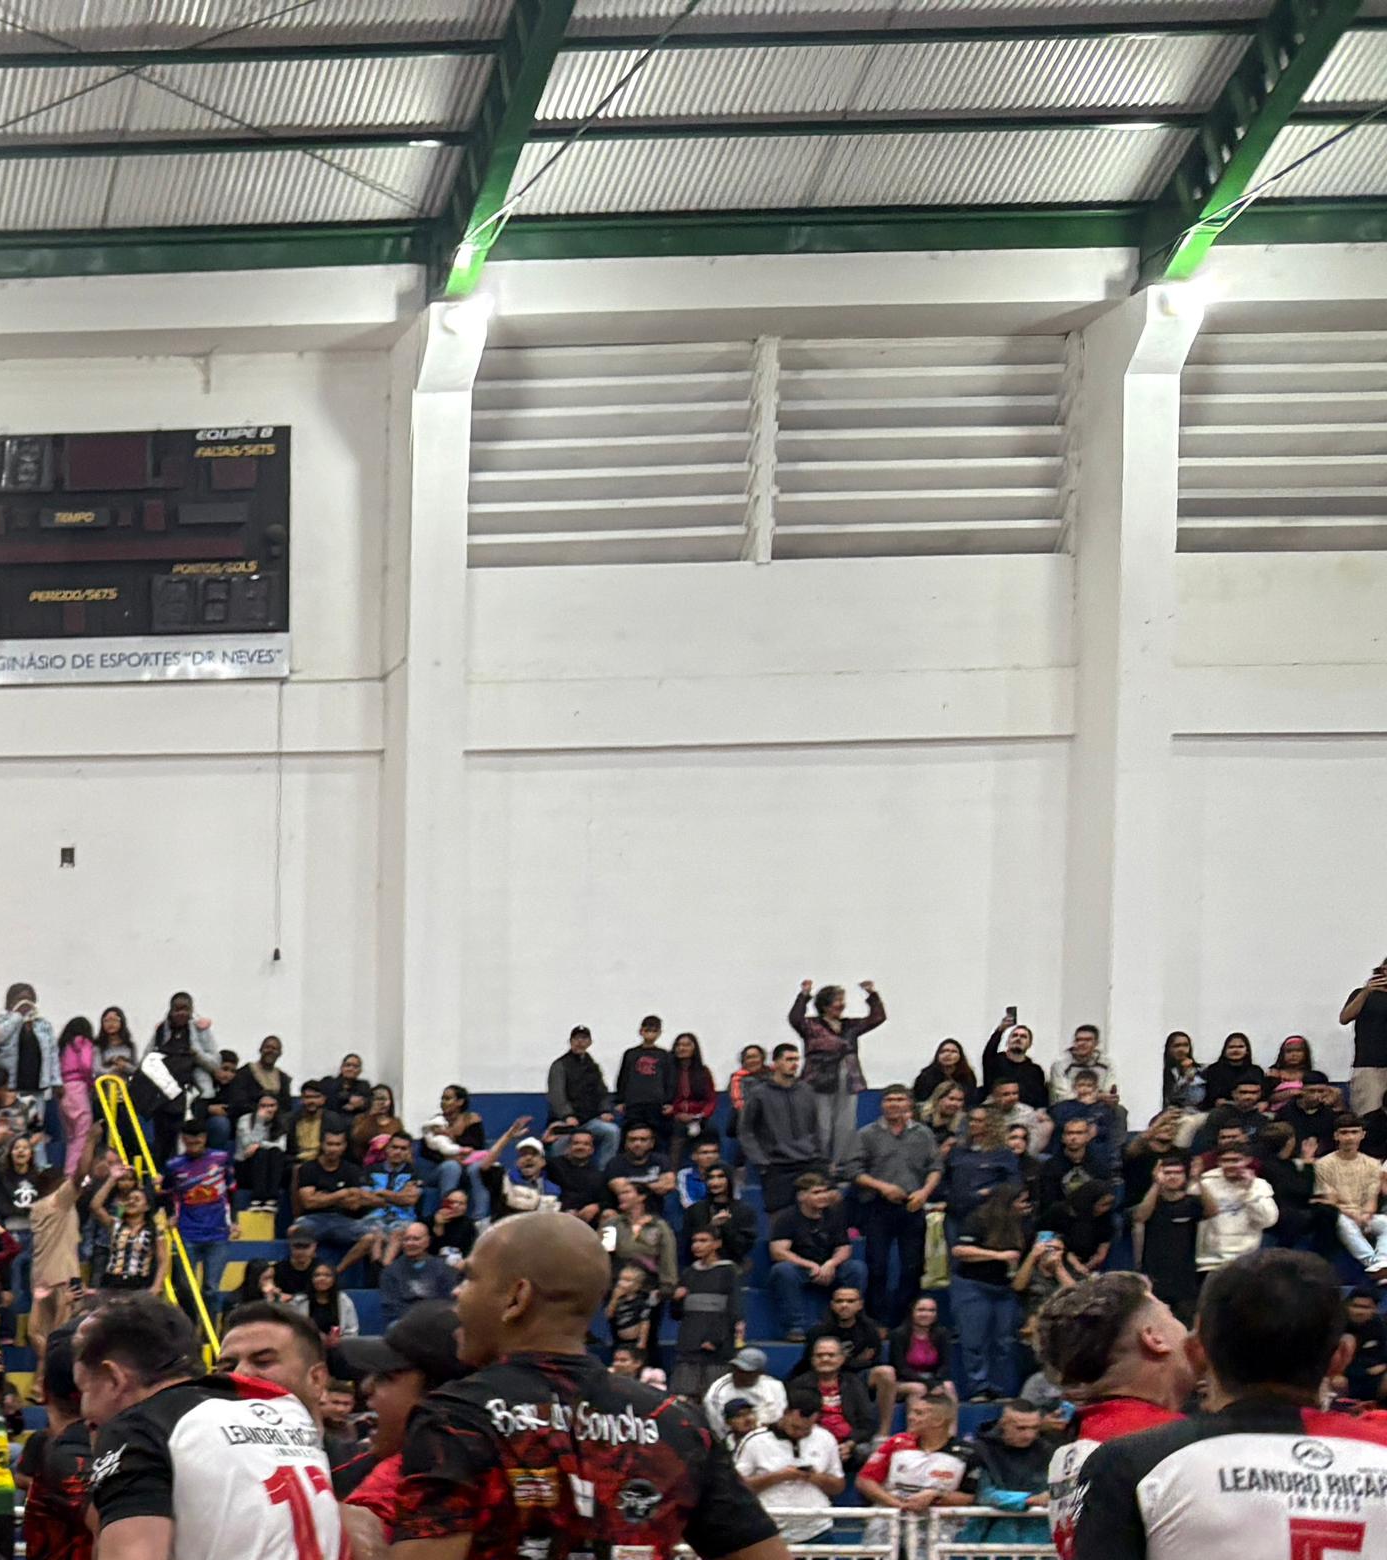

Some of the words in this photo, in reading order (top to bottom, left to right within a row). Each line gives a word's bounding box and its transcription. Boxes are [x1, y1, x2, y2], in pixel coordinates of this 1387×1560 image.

[54, 512, 95, 524] TEMPO
[71, 653, 94, 669] DE
[100, 652, 181, 668] ESPORTES
[1218, 1467, 1322, 1497] LEANDRO
[1326, 1473, 1387, 1498] RICAR
